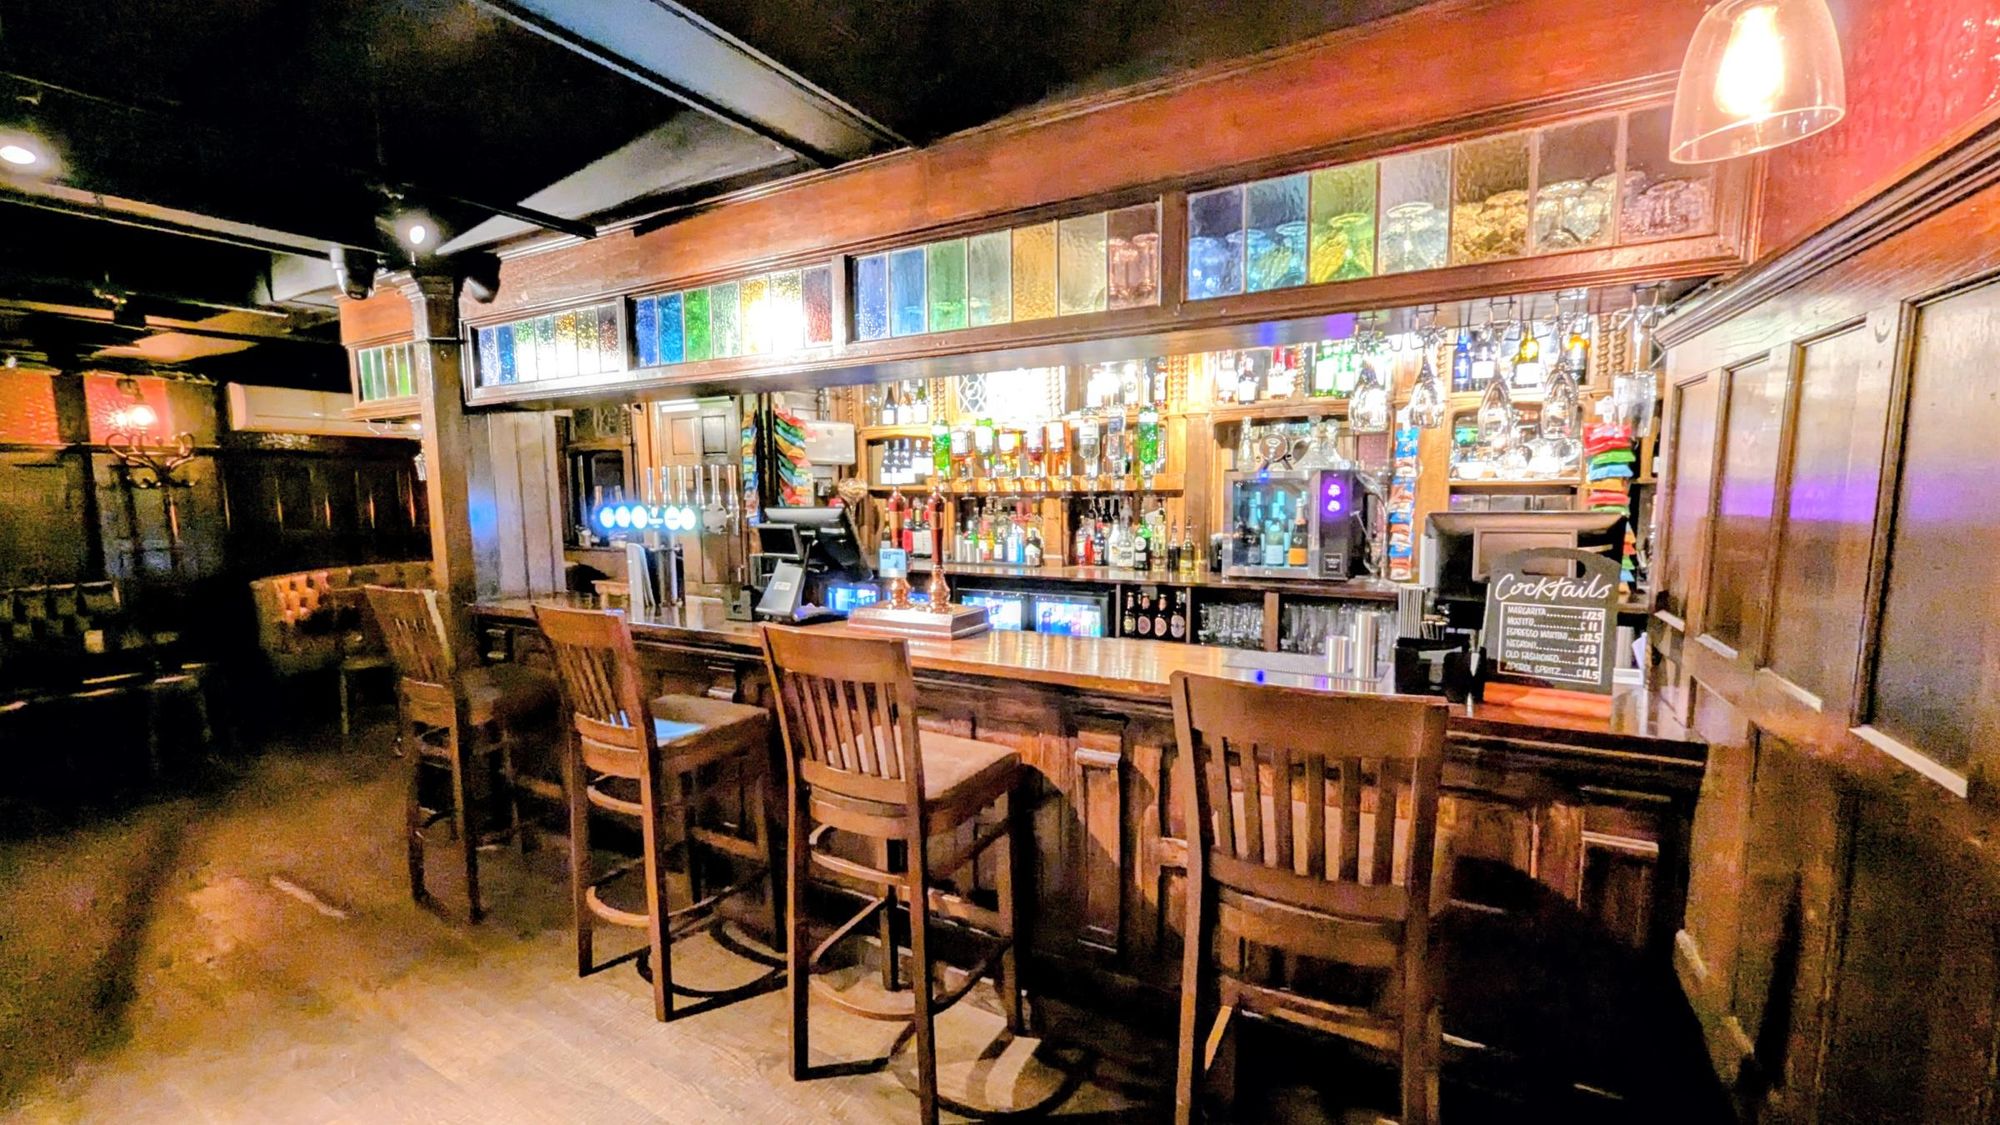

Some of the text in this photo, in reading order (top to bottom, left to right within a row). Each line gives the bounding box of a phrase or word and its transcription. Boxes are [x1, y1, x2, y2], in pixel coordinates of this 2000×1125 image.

[1495, 573, 1613, 601] Cocktails
[1507, 606, 1546, 616] MARGARITA
[1507, 616, 1535, 626] MOJITO
[1506, 627, 1539, 638] ESPRESSO
[1540, 630, 1569, 640] MARTINI
[1506, 639, 1537, 649] NEGRONI
[1505, 649, 1520, 659] OLD
[1521, 651, 1560, 663] FASHIONED
